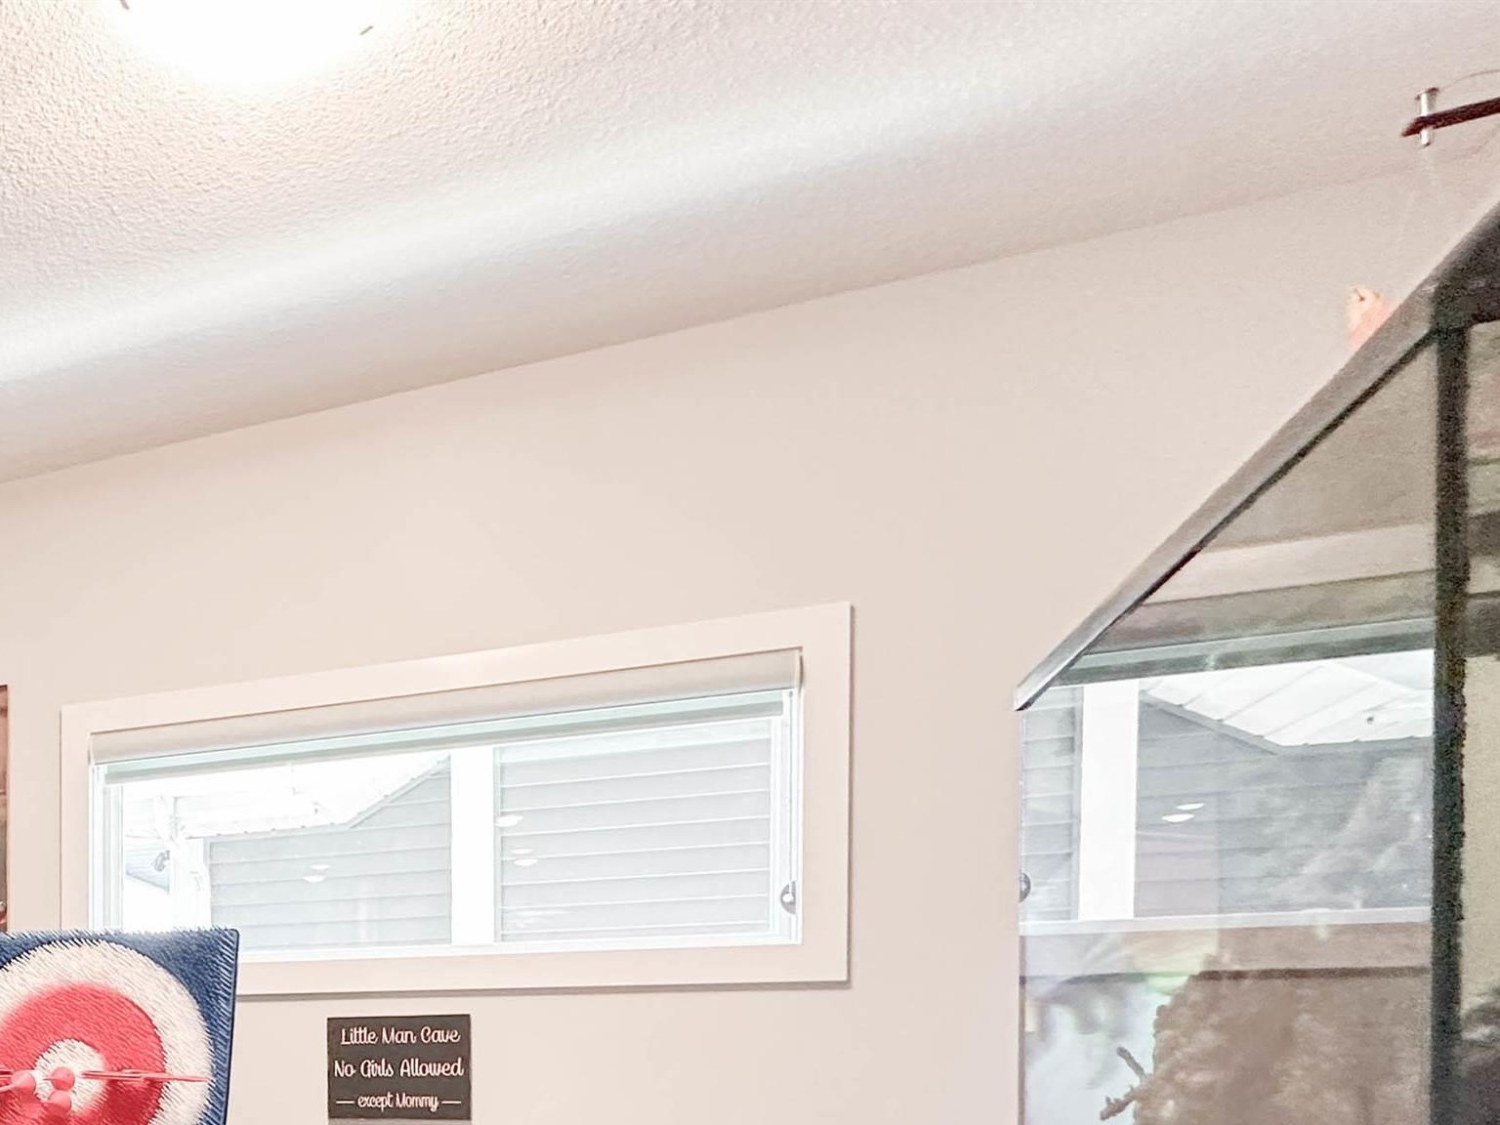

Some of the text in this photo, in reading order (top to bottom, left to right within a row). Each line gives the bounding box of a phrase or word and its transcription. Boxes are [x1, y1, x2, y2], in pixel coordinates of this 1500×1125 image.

[340, 1026, 461, 1045] Little Man Cave
[334, 1057, 465, 1078] No Girls Allowed
[358, 1093, 440, 1112] except Mommy
